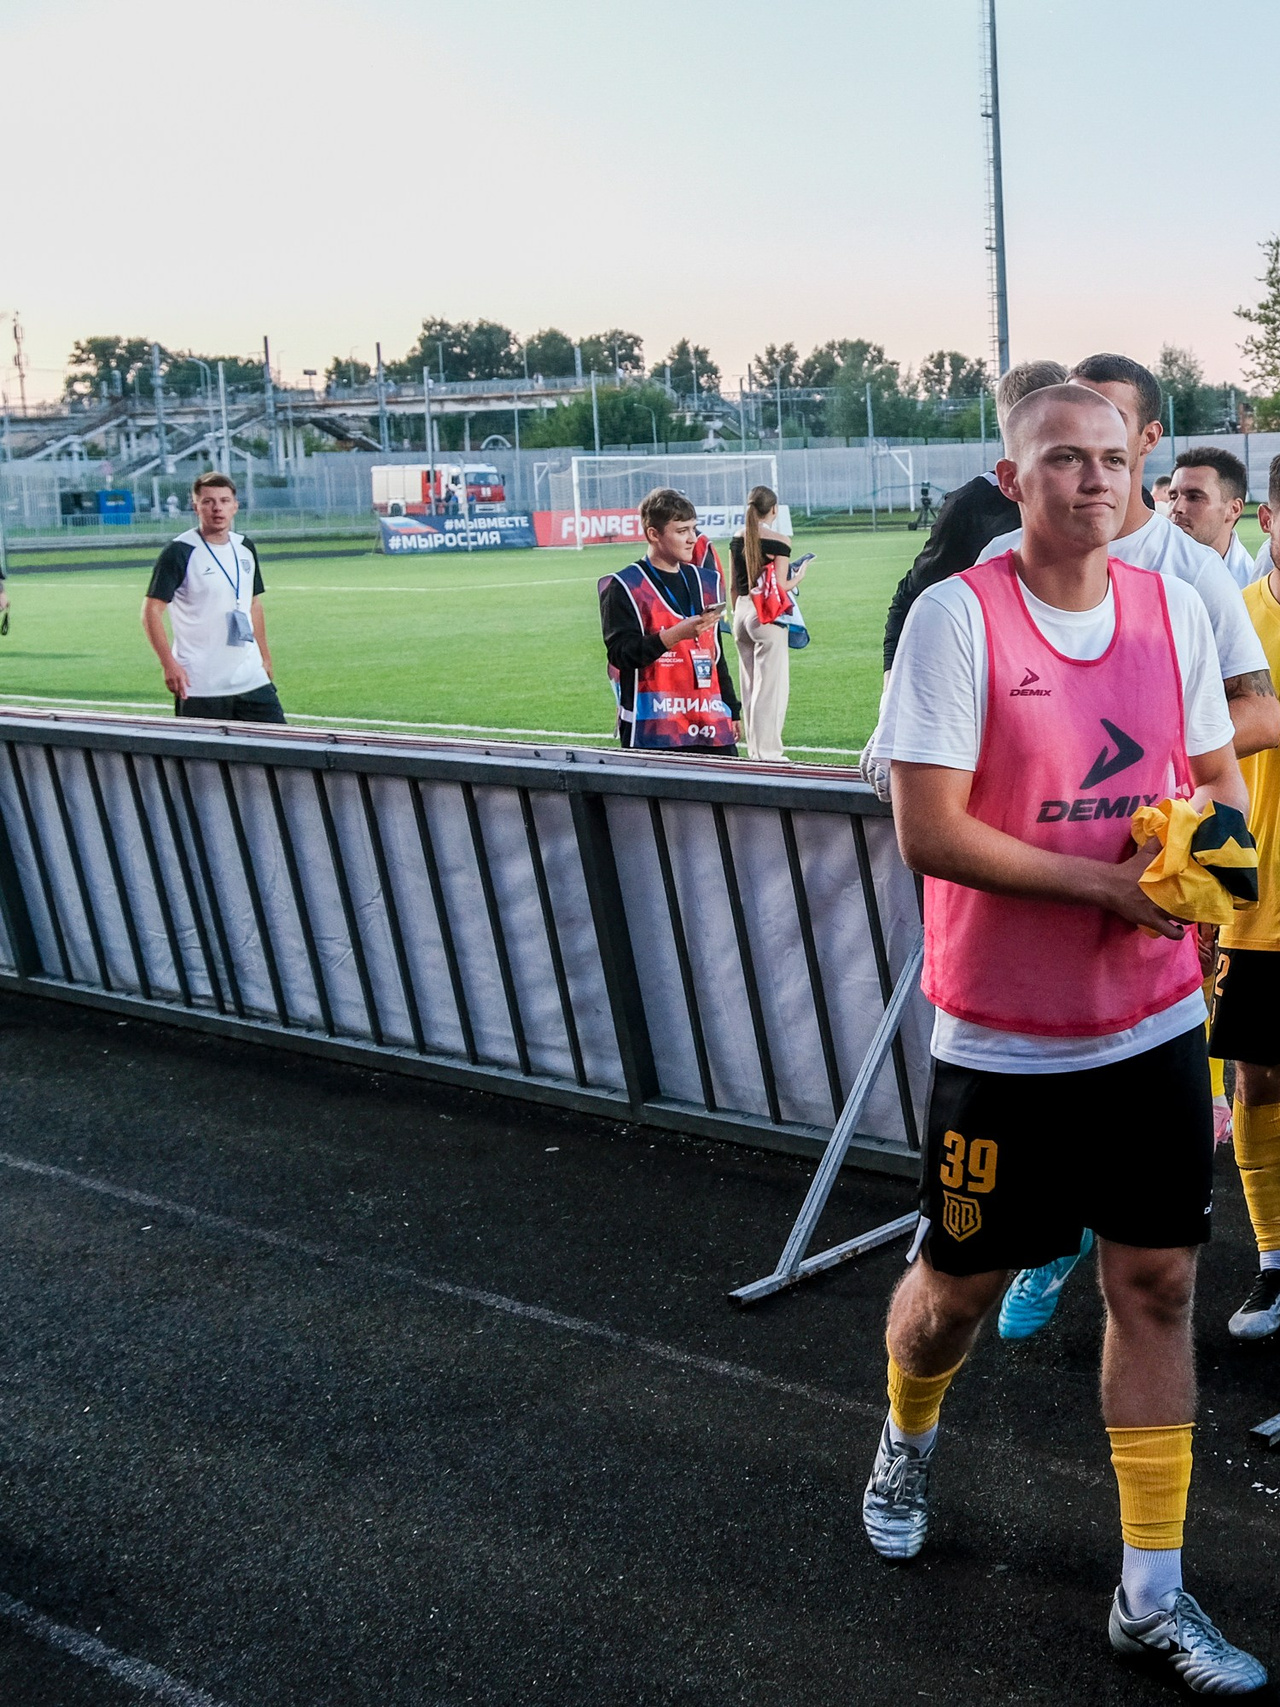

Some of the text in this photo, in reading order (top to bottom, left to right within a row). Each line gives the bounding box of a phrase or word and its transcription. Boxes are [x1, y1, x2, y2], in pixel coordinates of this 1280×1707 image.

[444, 516, 529, 531] #МЫВМЕСТЕ
[388, 531, 501, 550] #МЫРОССИЯ
[1009, 688, 1052, 697] DEMIX
[940, 1129, 998, 1194] 39
